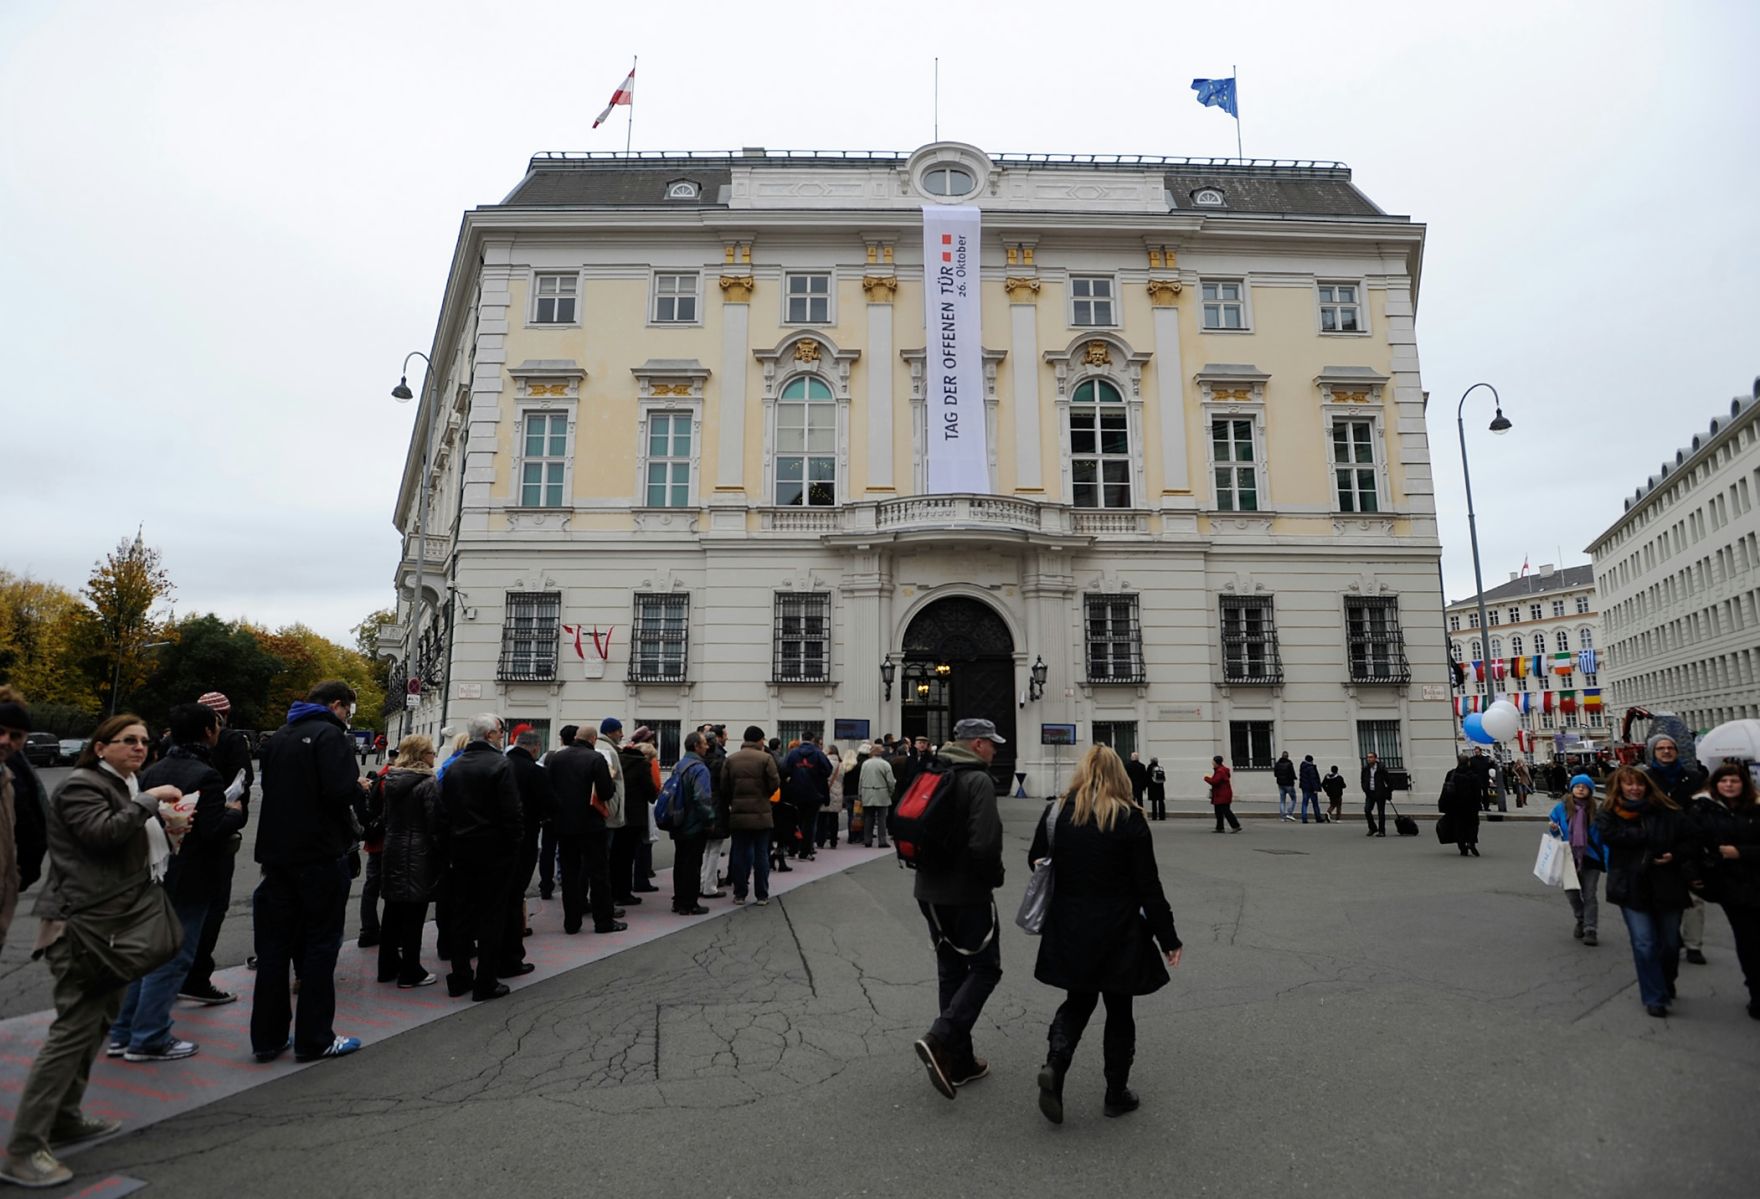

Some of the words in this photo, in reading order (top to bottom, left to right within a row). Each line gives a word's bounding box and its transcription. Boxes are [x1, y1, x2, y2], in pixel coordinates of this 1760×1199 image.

[956, 235, 967, 278] Oktober
[937, 266, 954, 295] TÜR
[957, 281, 967, 298] 26.
[941, 302, 957, 369] OFFENEN
[943, 375, 958, 406] DER
[944, 412, 959, 441] TAG
